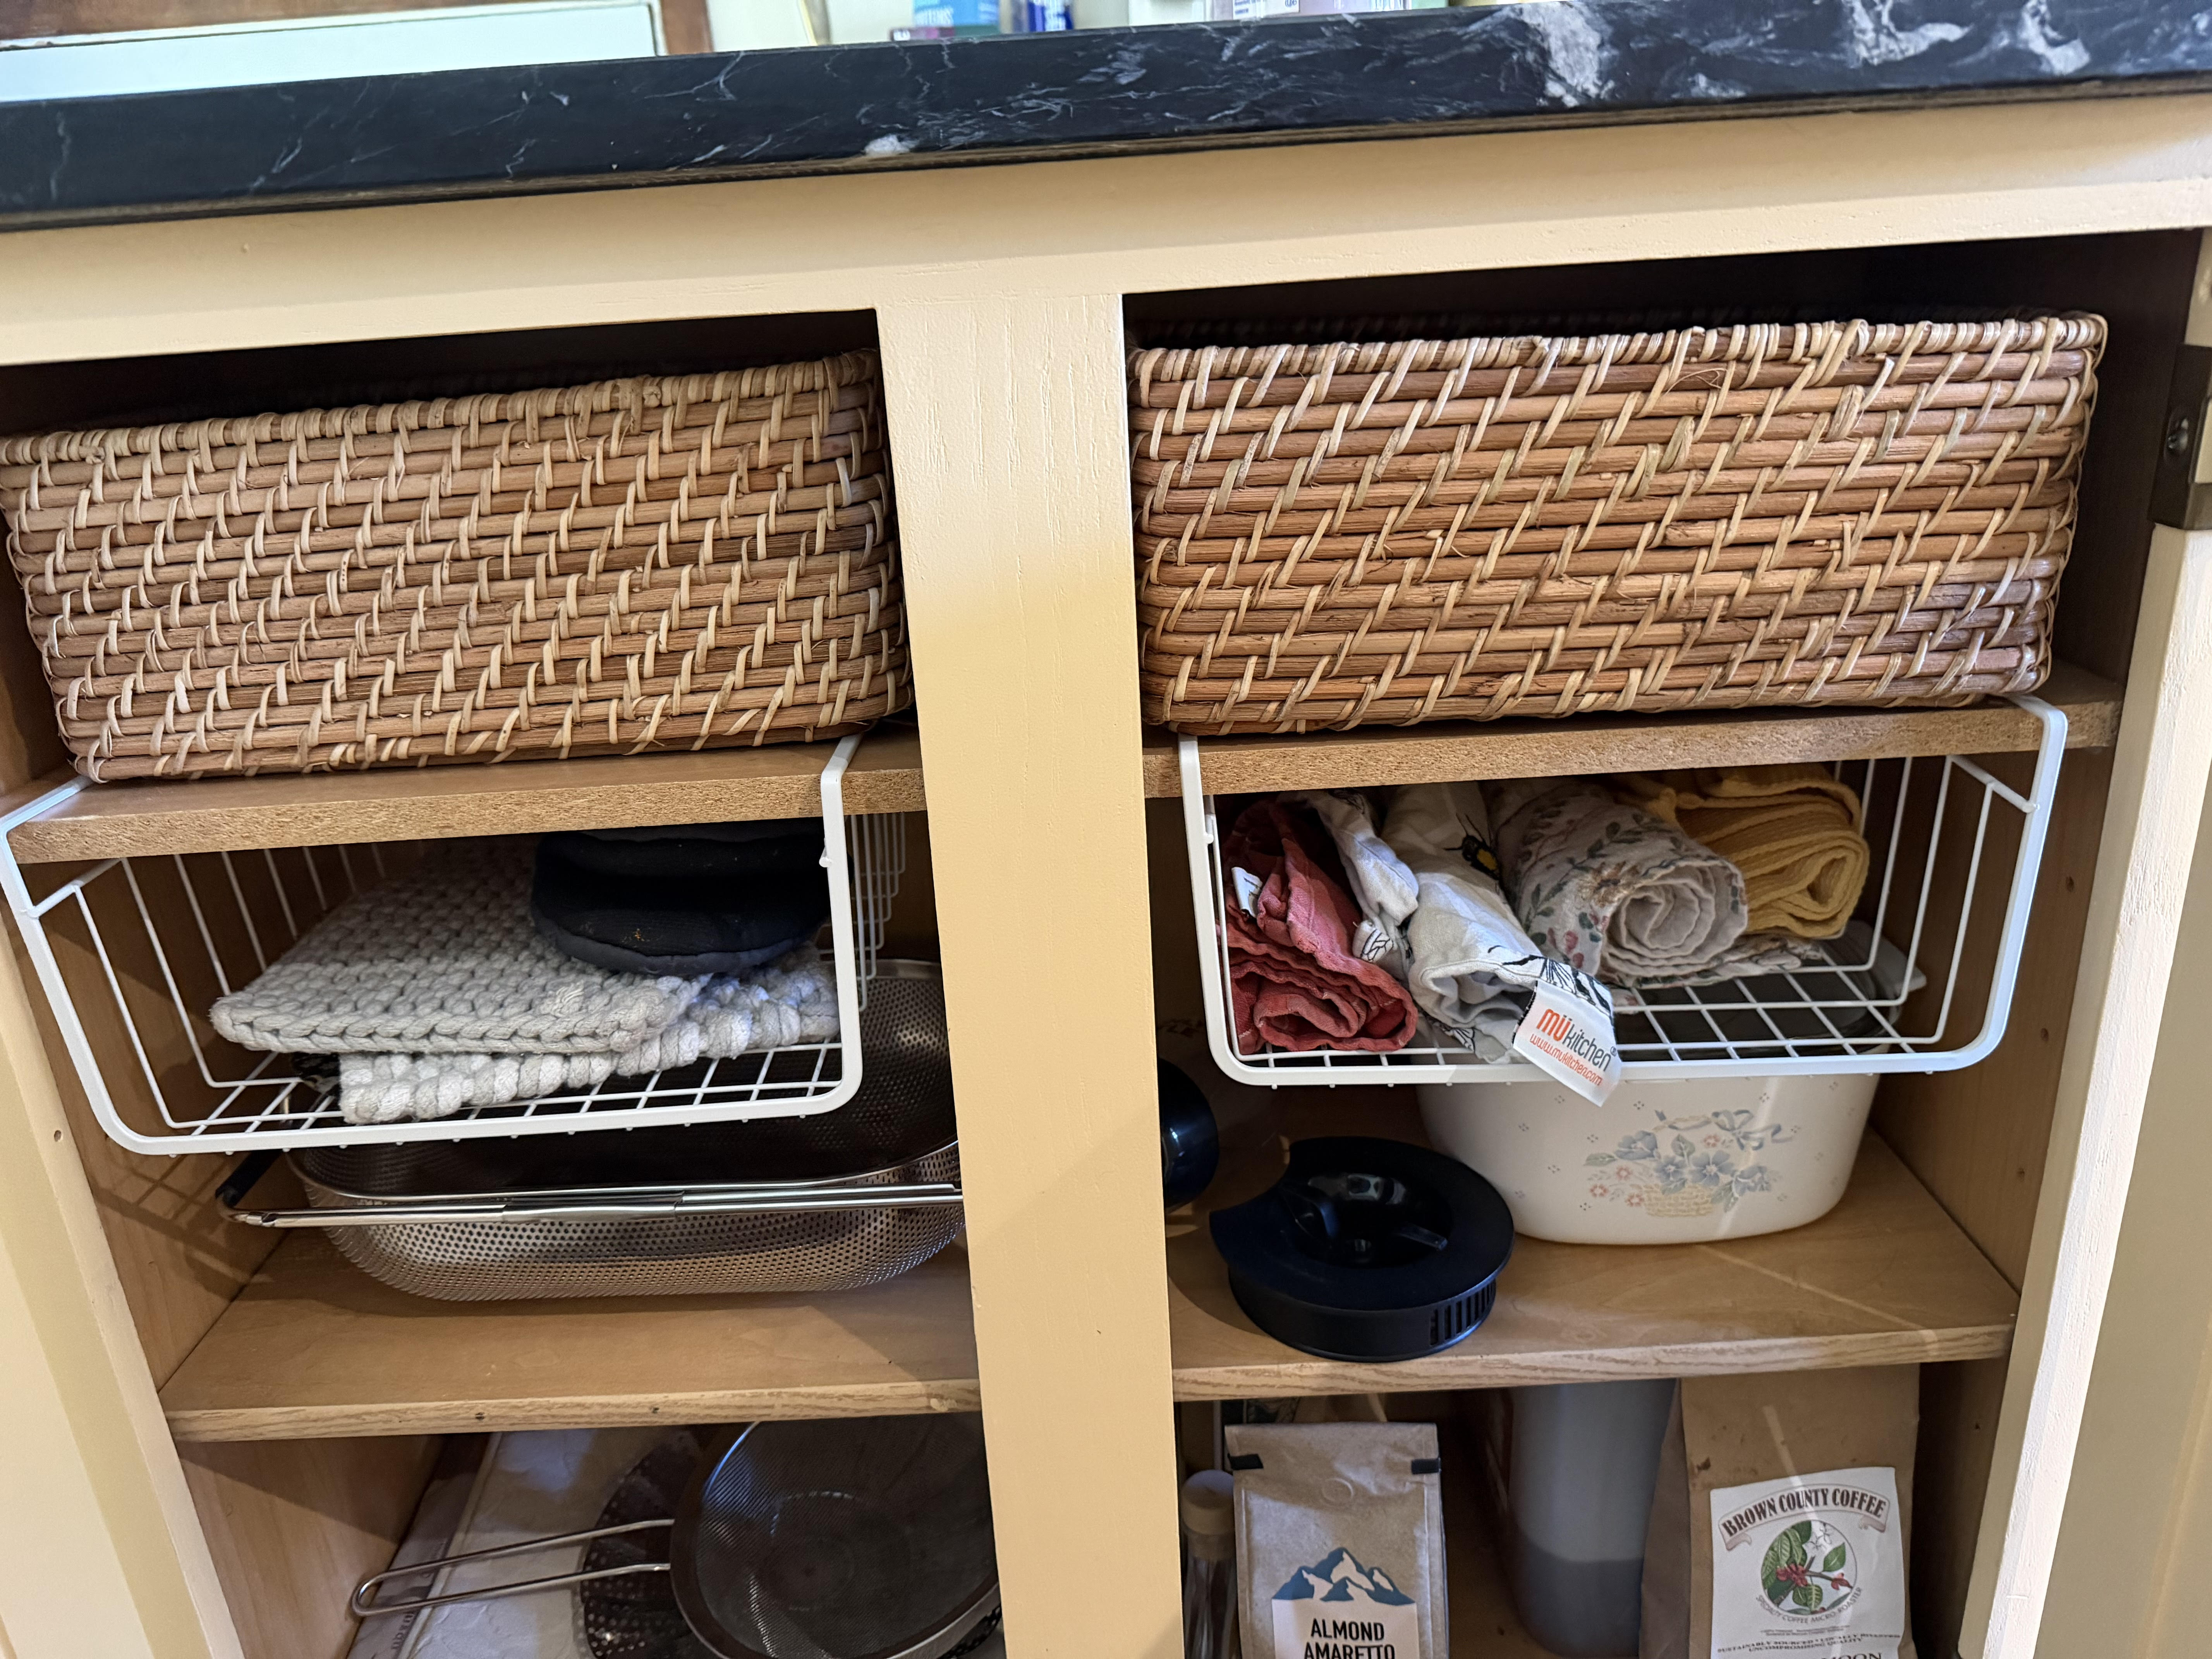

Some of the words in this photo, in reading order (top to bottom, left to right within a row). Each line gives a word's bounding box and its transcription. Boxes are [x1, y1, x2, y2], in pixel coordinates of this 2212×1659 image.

[1530, 1034, 1603, 1086] www.mukitchen.com
[1721, 1498, 1778, 1537] BROWN
[1779, 1488, 1828, 1512] COUNTY
[1832, 1488, 1886, 1518] COFFEE
[1311, 1618, 1384, 1641] ALMOND
[1782, 1614, 1808, 1623] COFFEE
[1304, 1642, 1395, 1659] AMARETTO
